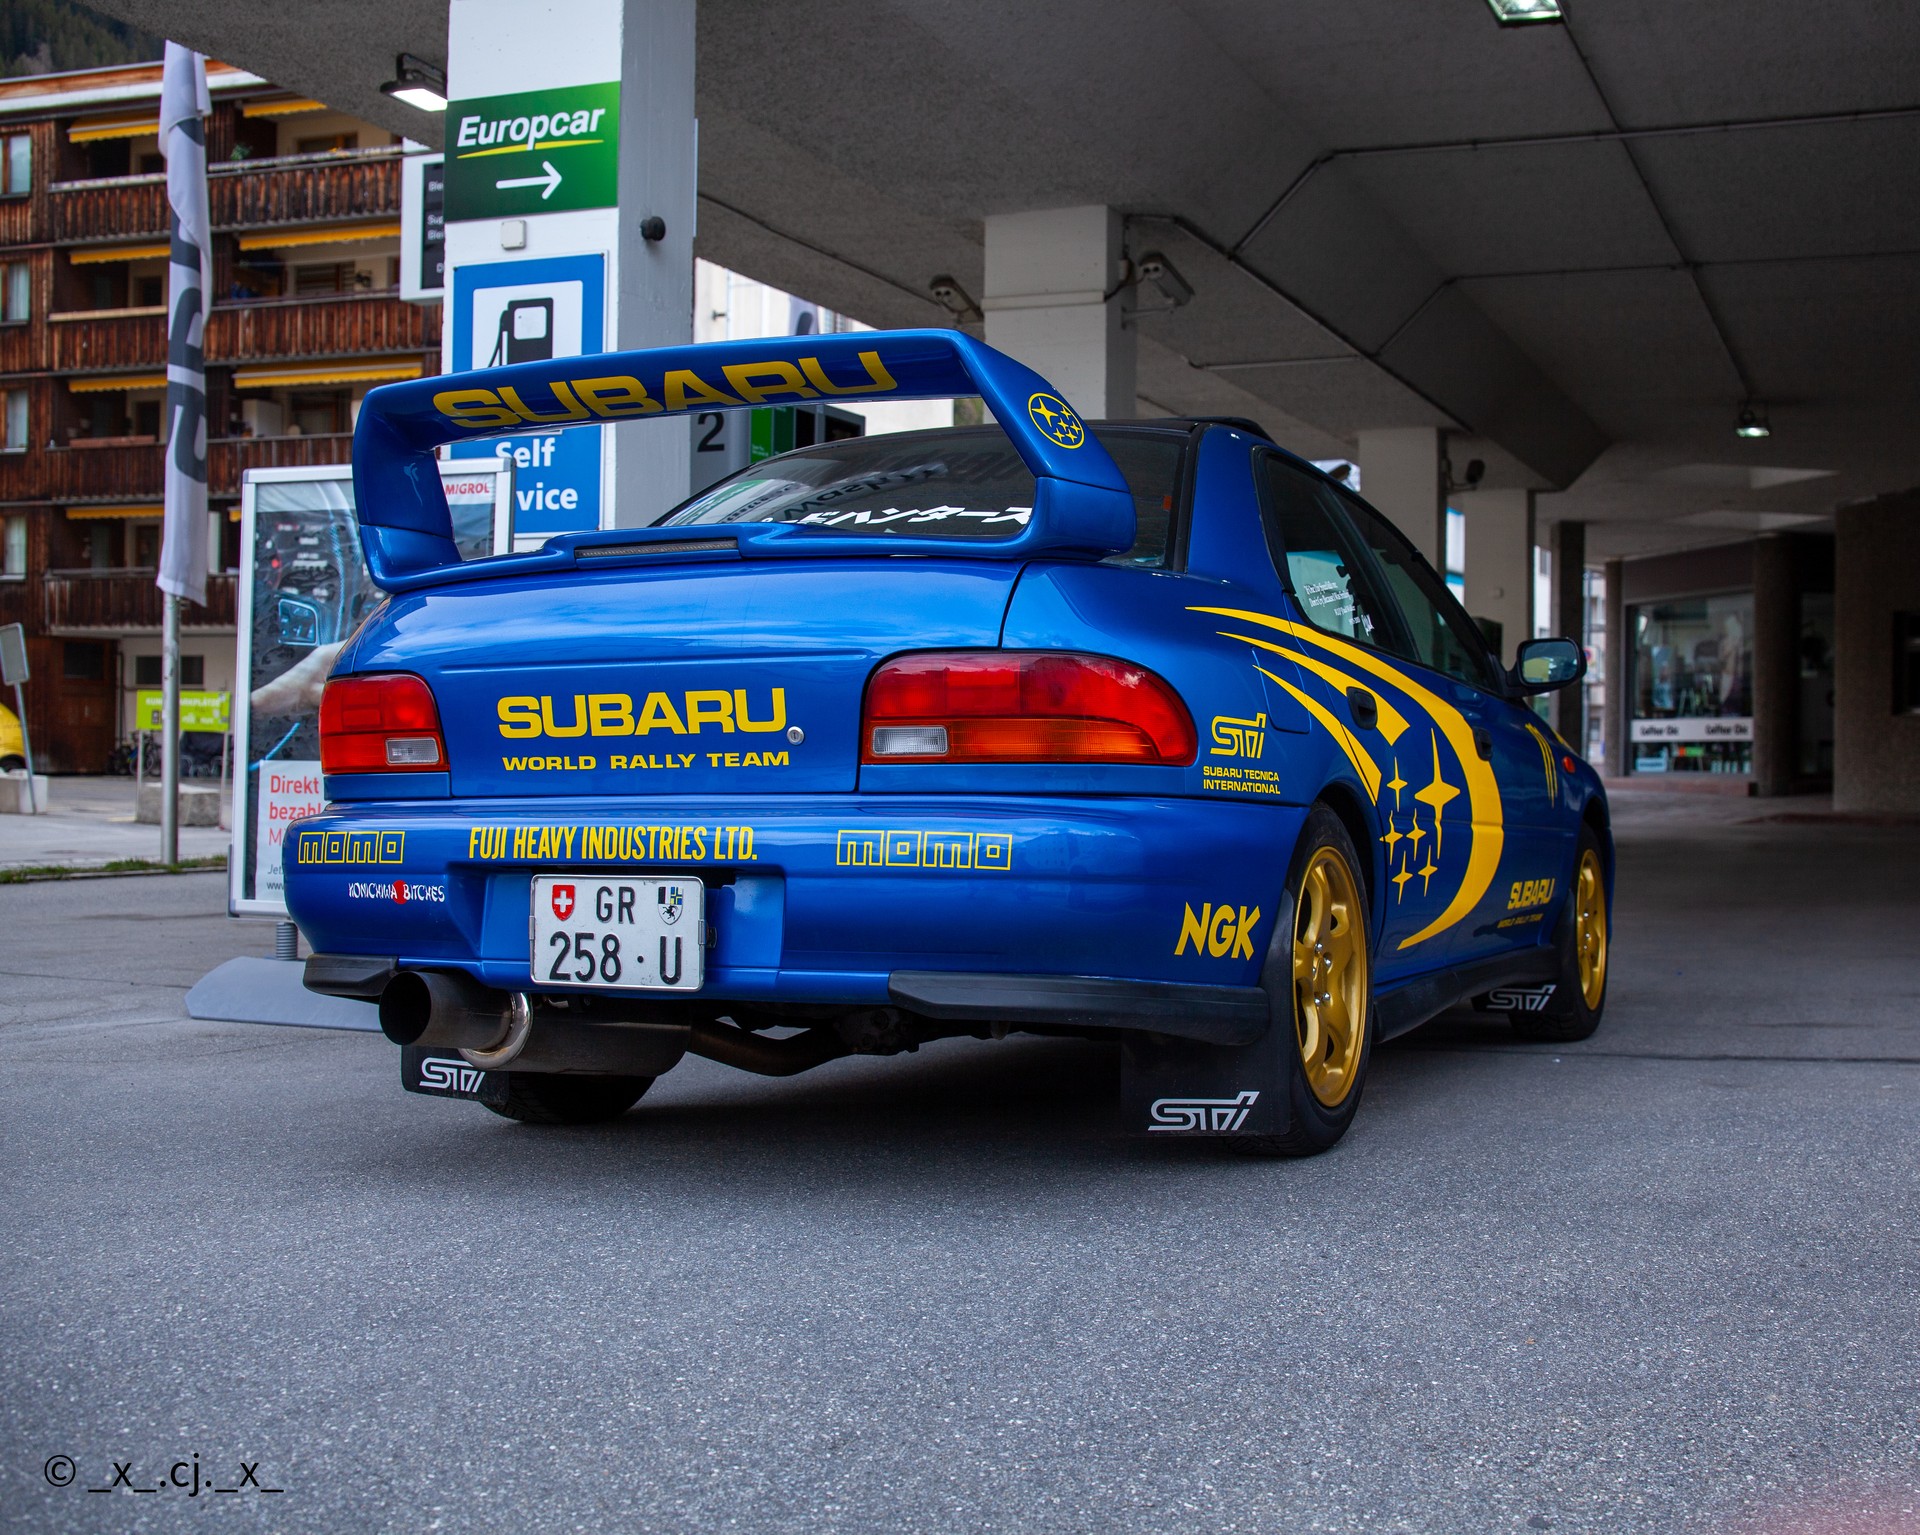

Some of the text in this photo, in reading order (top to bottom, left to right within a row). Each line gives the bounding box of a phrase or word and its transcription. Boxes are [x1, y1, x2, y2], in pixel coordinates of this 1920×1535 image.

[457, 108, 606, 150] Europcar
[433, 351, 898, 428] SUBARU
[697, 412, 725, 453] 2
[495, 437, 556, 469] Self
[445, 482, 490, 495] MIGROL
[497, 688, 787, 738] SUBARU
[502, 751, 790, 771] WORLD RALLY TEAM
[1203, 765, 1280, 782] SUBARU TECNICA
[270, 775, 319, 794] Direkt
[1203, 779, 1281, 795] INTERNATIONAL
[469, 826, 758, 861] FUJI HEAVY INDUSTRIES LTD.
[403, 883, 446, 903] BITCHES
[595, 886, 637, 924] GR
[1507, 878, 1555, 910] SUBARU
[1174, 901, 1261, 961] NGK
[549, 930, 682, 985] 258 U
